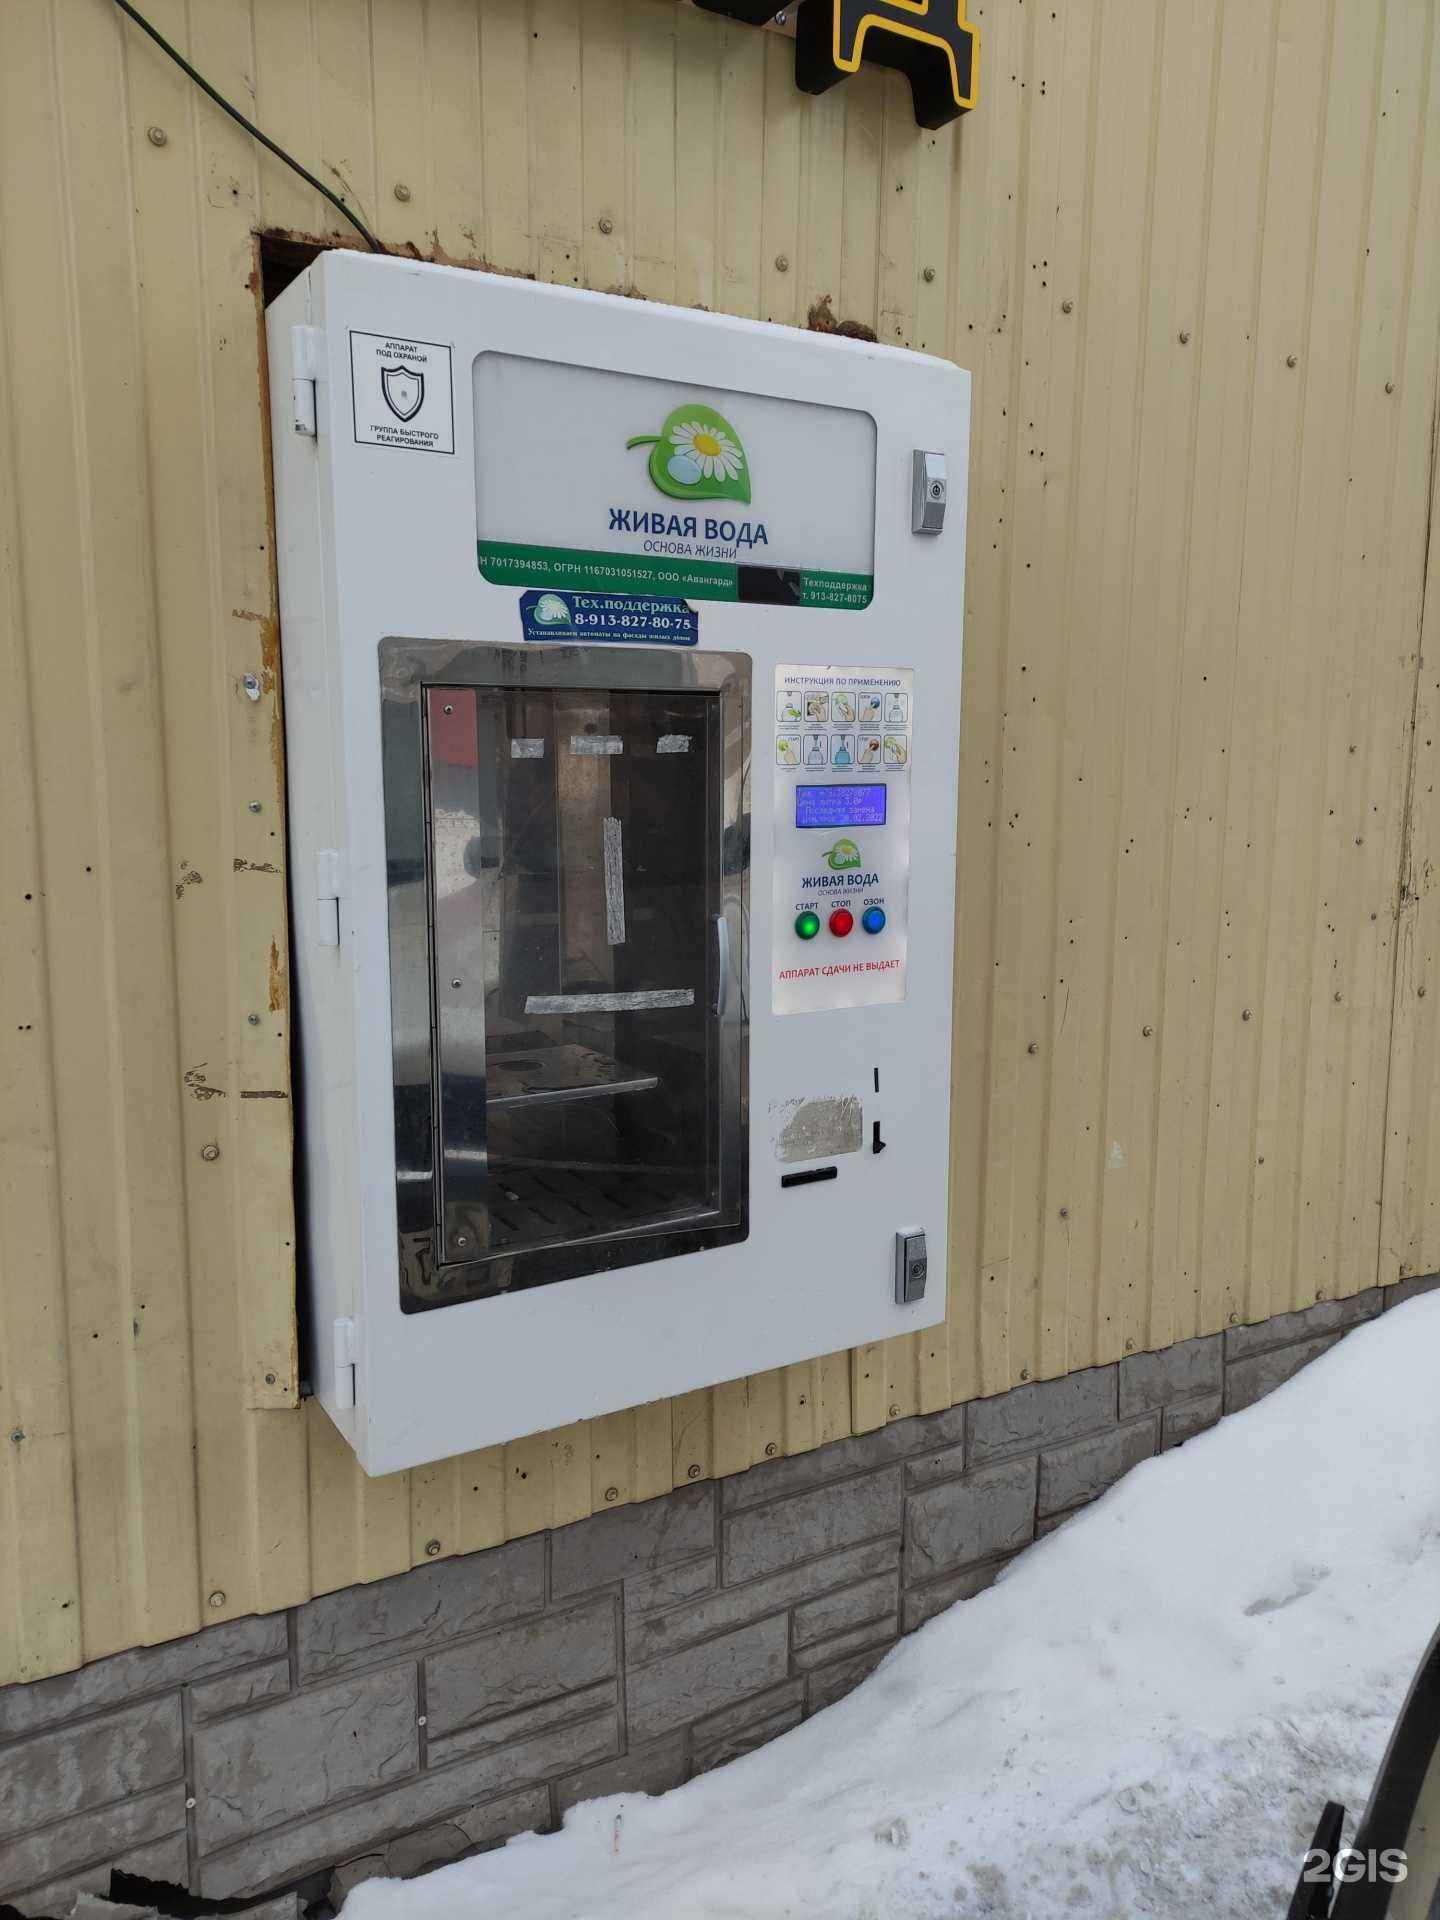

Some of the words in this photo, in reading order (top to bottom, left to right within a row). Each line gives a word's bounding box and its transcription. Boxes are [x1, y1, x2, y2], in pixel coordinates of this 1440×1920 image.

[385, 342, 418, 353] АППАРАТ
[376, 349, 392, 358] ПОД
[393, 352, 427, 362] ОХРАНОЙ
[370, 425, 398, 434] ГРУППА
[400, 429, 439, 440] БЫСТРОГО
[376, 435, 434, 447] РЕАГИРОВАНИЯ
[608, 508, 697, 538] ЖИВАЯ
[705, 518, 768, 549] ВОДА
[643, 540, 692, 556] ОСНОВА
[694, 544, 737, 559] ЖИЗНИ
[554, 562, 581, 573] ОГРН
[658, 571, 680, 582] ООО
[682, 574, 733, 588] «Авангард»
[802, 576, 867, 591] Техподдержка
[574, 613, 691, 630] 8-913-827-80-75
[784, 676, 834, 686] ИНСТРУКЦИЯ
[835, 678, 847, 686] ПО
[848, 679, 901, 687] ПРИМЕНЕНИЮ
[802, 875, 844, 888] ЖИВАЯ
[847, 873, 879, 887] ВОДА
[843, 887, 864, 895] ЖИЗНИ
[795, 902, 819, 911] СТАРТ
[831, 899, 851, 908] СТОП
[863, 897, 885, 906] ОЗОН
[779, 966, 819, 980] АППАРАТ
[821, 963, 851, 977] СДАЧИ
[853, 961, 865, 972] НЕ
[866, 959, 901, 970] ВЫДАЕТ
